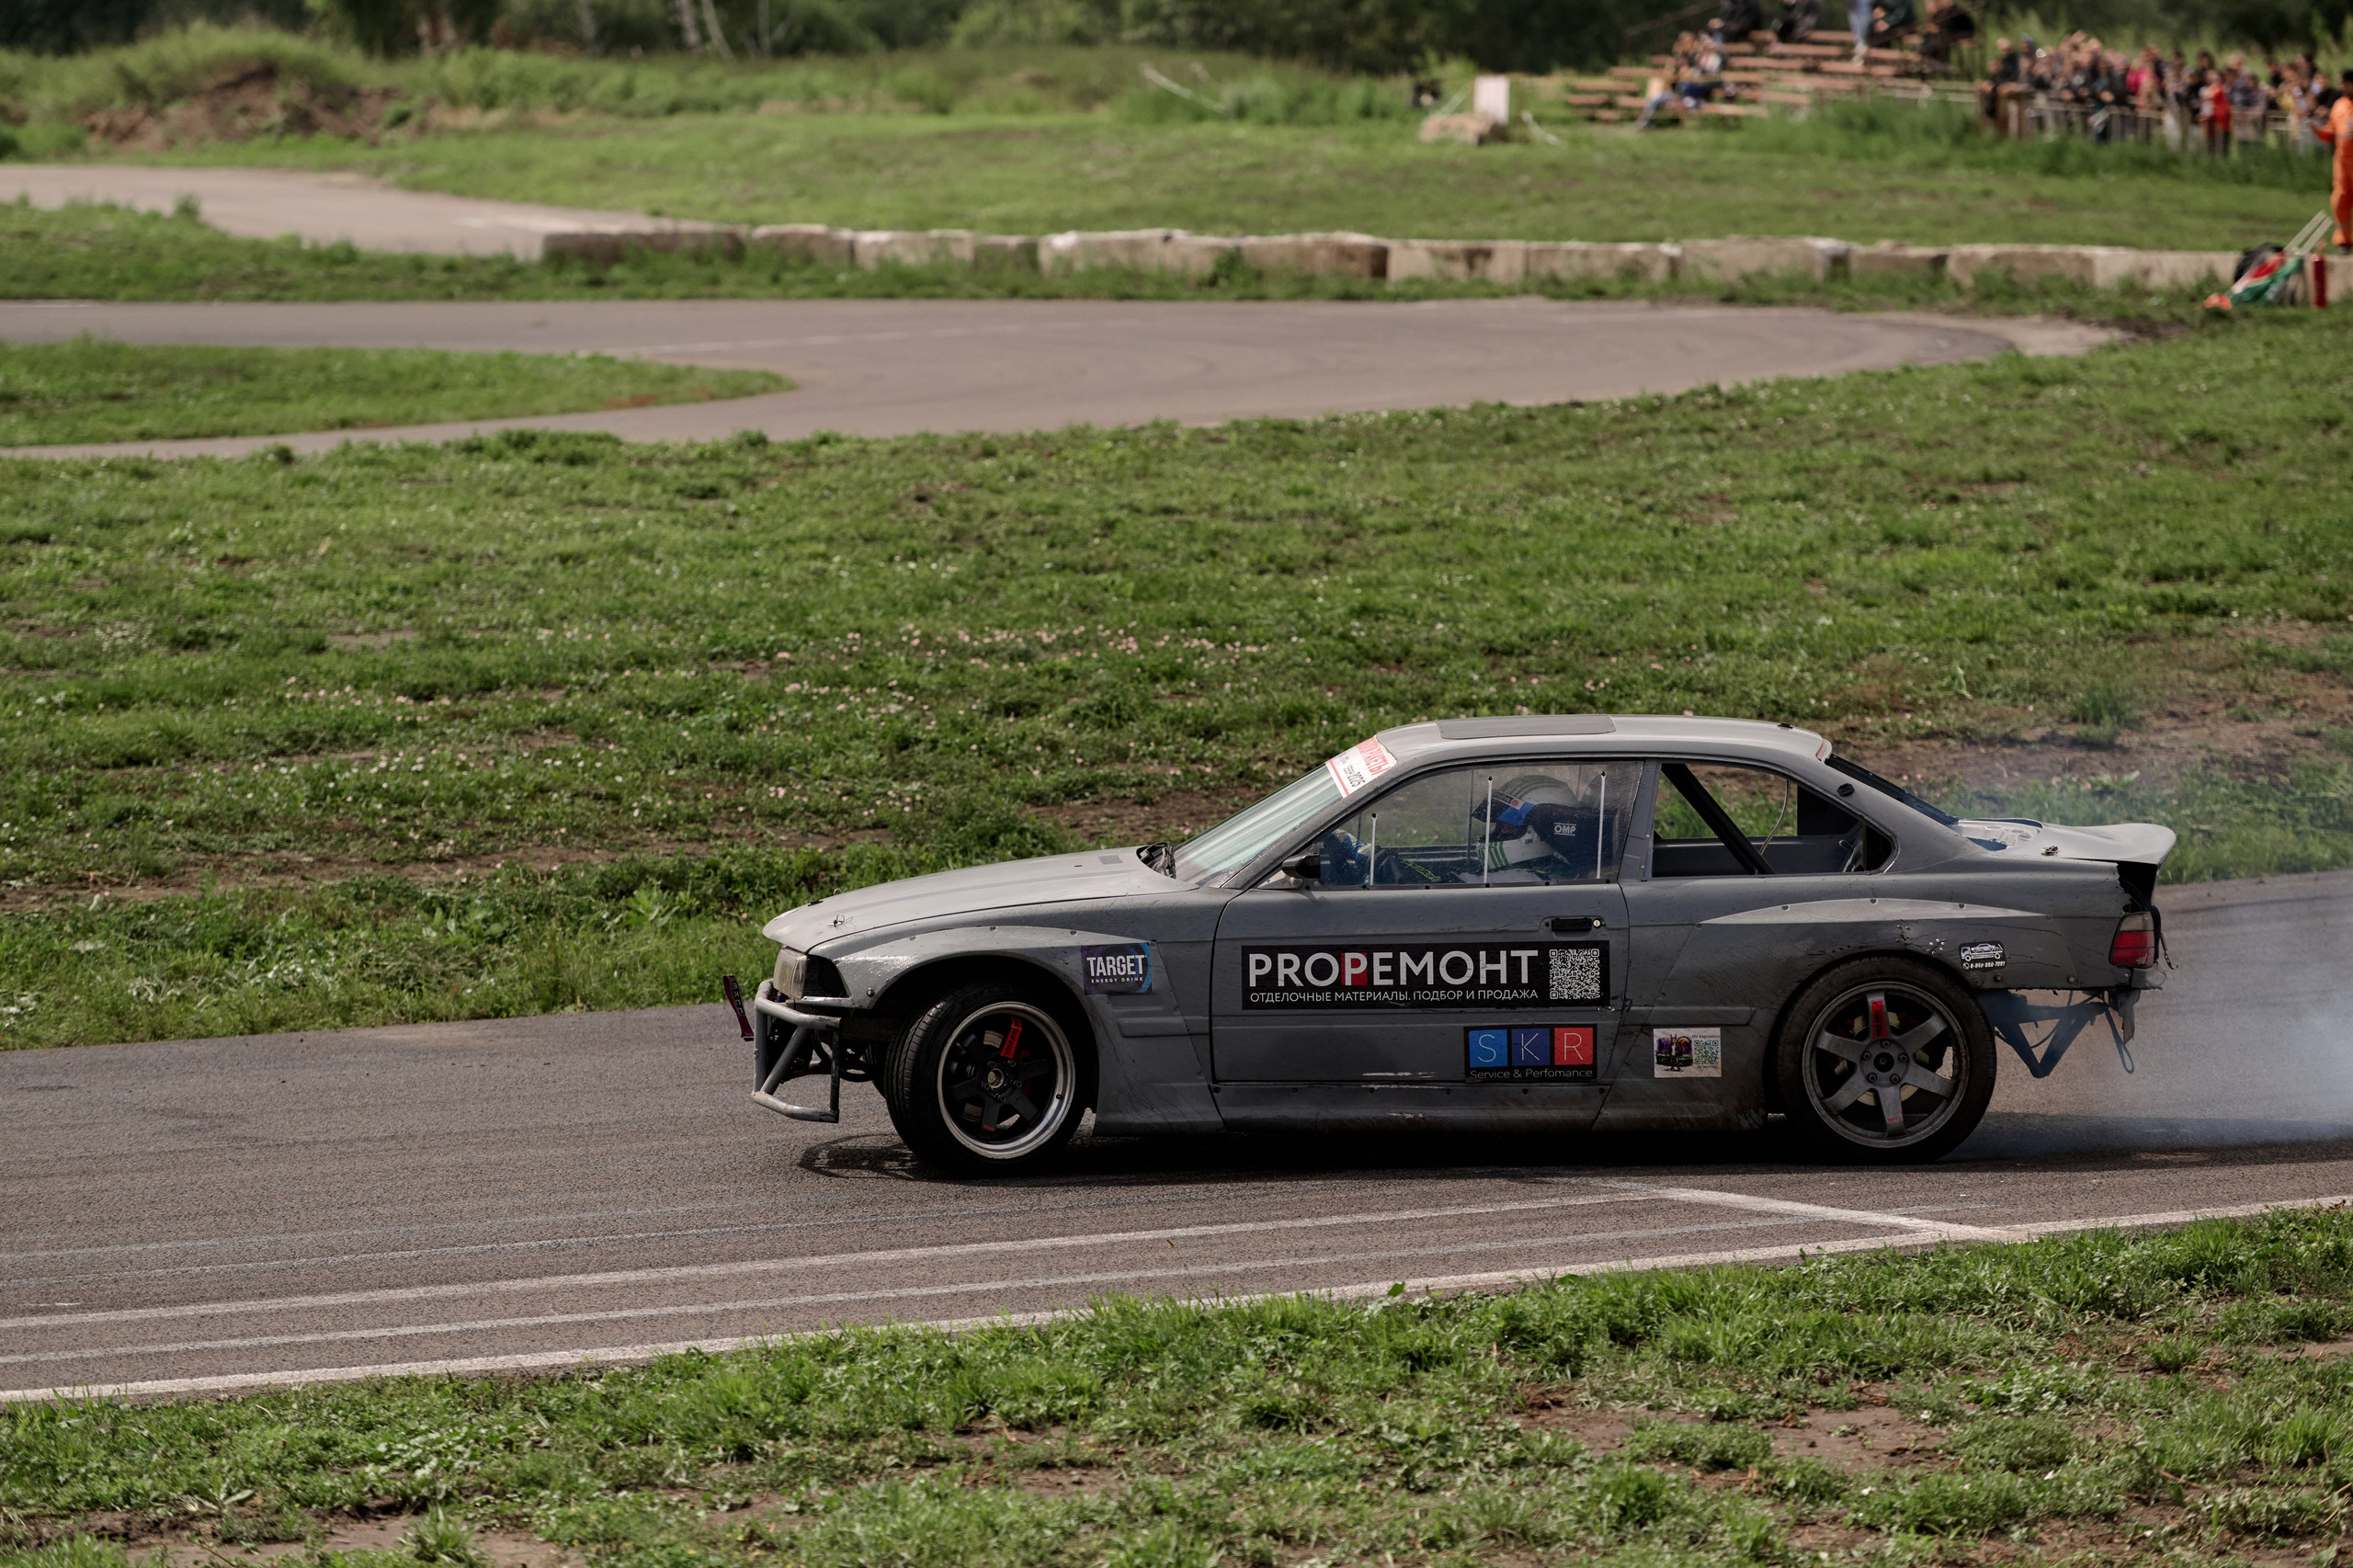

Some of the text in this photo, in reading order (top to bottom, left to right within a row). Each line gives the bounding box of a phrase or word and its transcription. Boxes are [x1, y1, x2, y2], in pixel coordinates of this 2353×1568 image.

[1553, 825, 1576, 835] OMP
[1086, 954, 1145, 977] TARGET
[1250, 989, 1539, 1004] ОТДЕЛОЧНЫЕ МАТЕРИАЛЫ. ПОДБОР И ПРОДАЖА
[1471, 1068, 1593, 1080] Service & Perfomance
